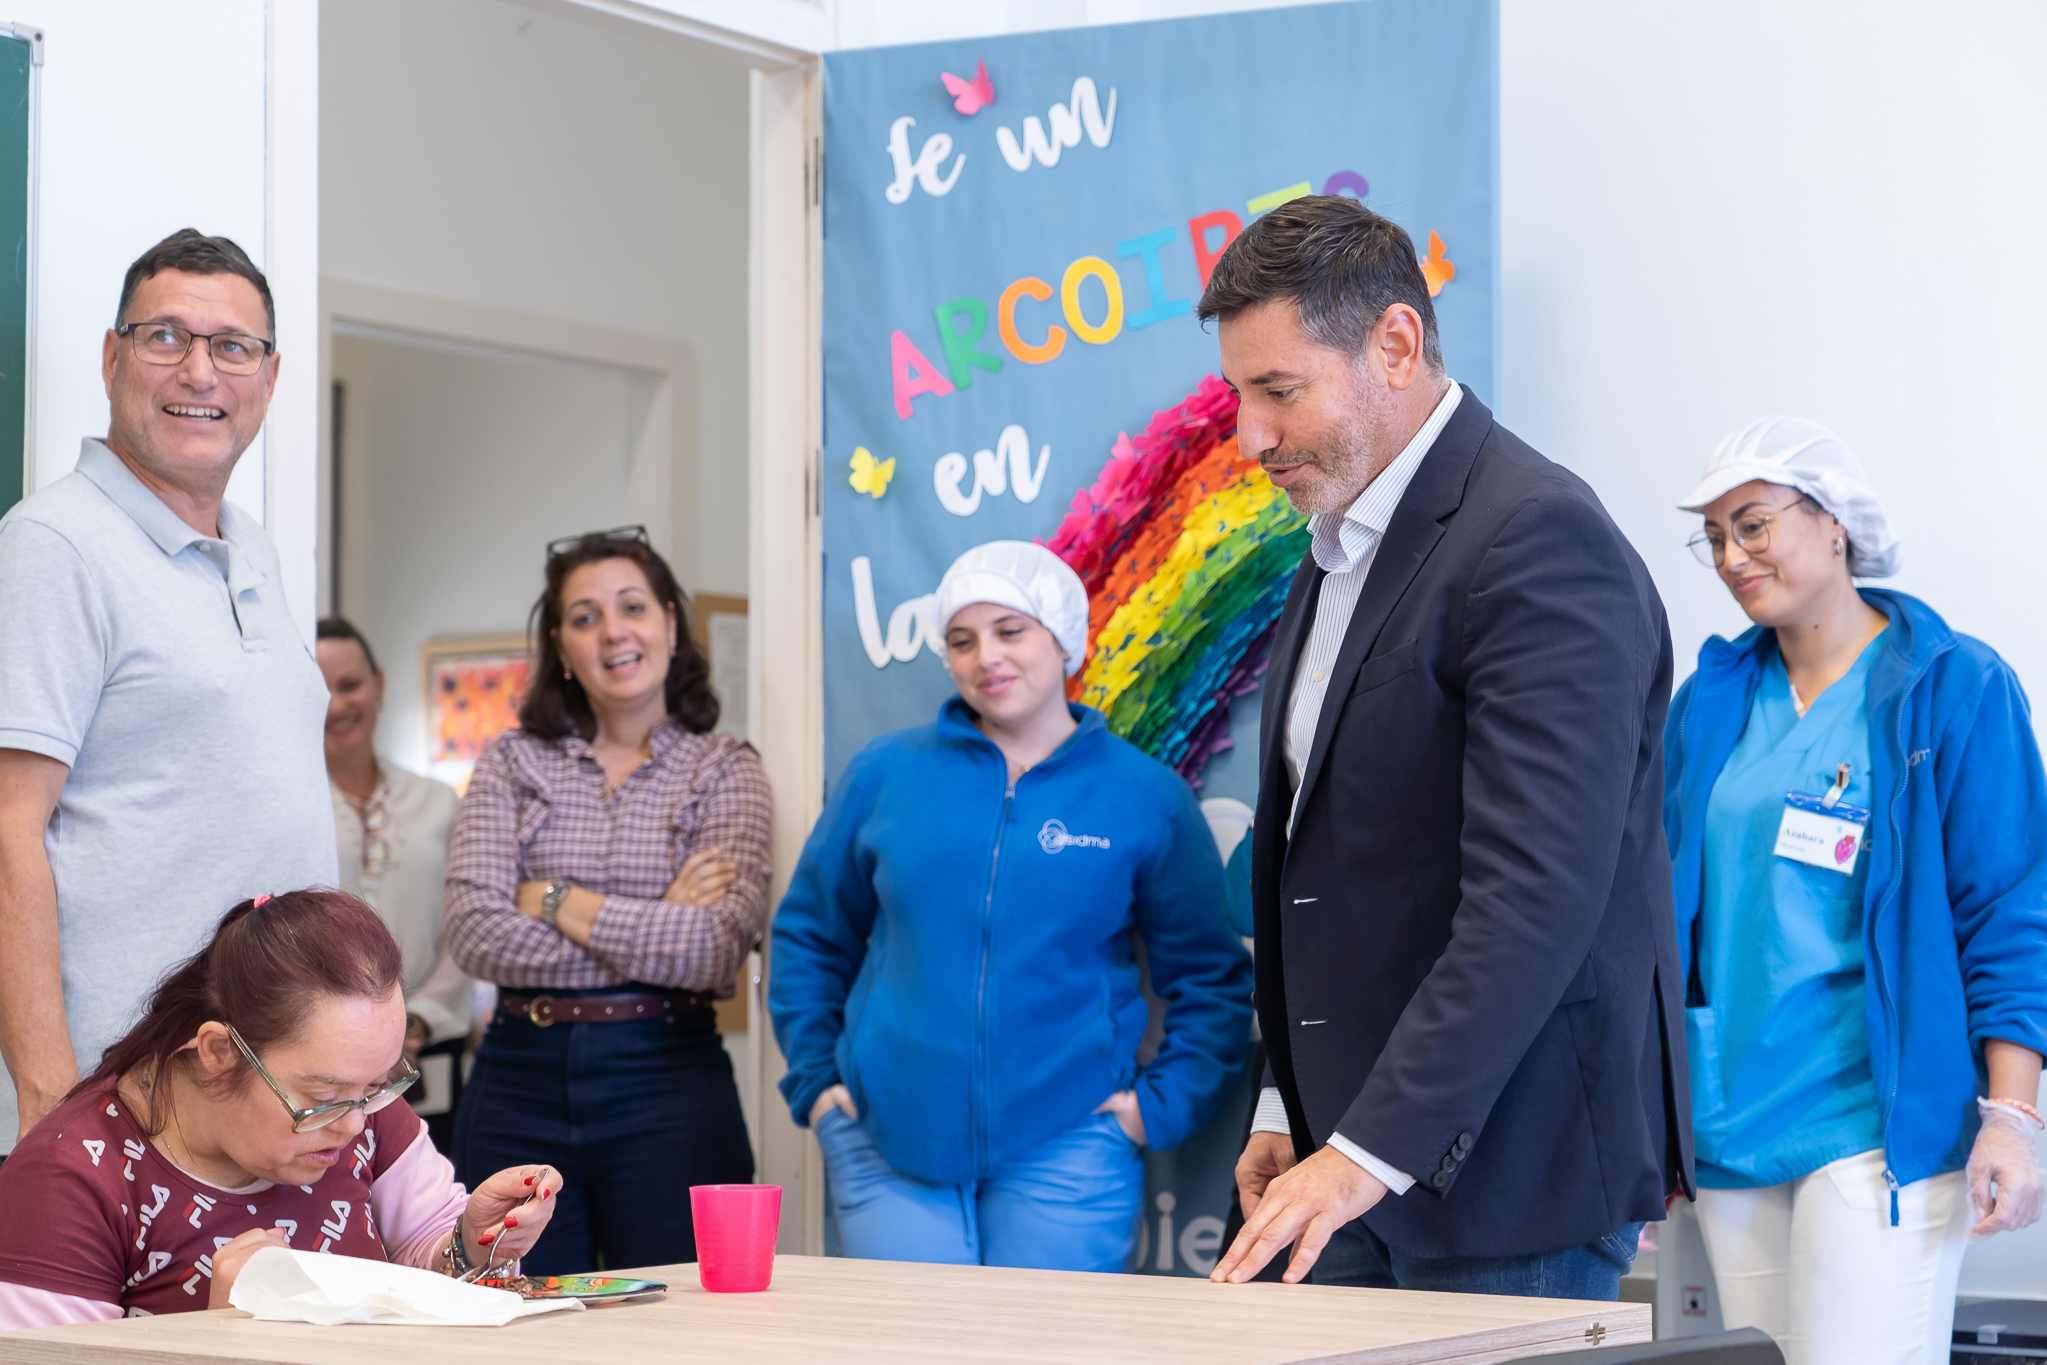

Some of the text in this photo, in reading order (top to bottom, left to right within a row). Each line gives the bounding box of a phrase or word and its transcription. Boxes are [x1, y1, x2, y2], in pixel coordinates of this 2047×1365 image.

[995, 75, 1117, 171] un
[933, 424, 1051, 517] en
[132, 1183, 171, 1251] FILA
